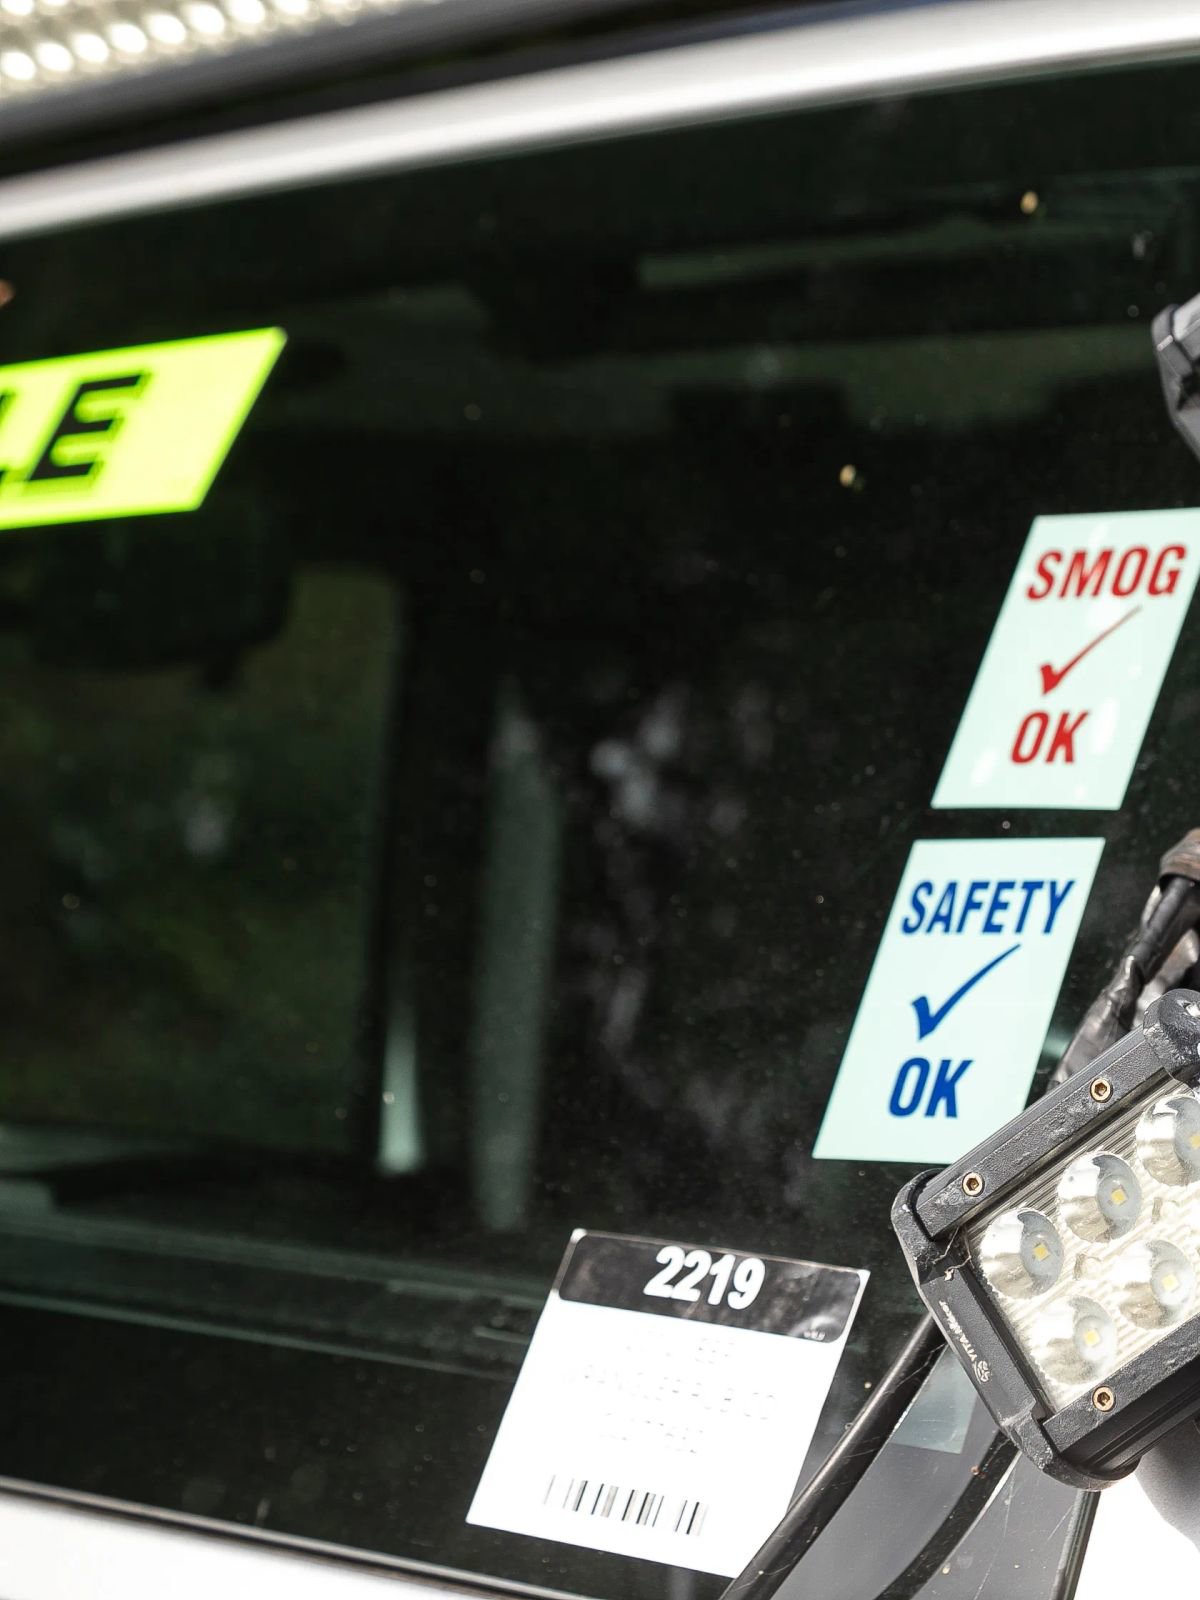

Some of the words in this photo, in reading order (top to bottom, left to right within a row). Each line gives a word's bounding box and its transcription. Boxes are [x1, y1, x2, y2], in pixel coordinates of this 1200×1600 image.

[1027, 545, 1186, 600] SMOG
[1011, 711, 1086, 764] OK
[901, 880, 1075, 935] SAFETY
[888, 1057, 972, 1119] OK
[644, 1246, 765, 1309] 2219
